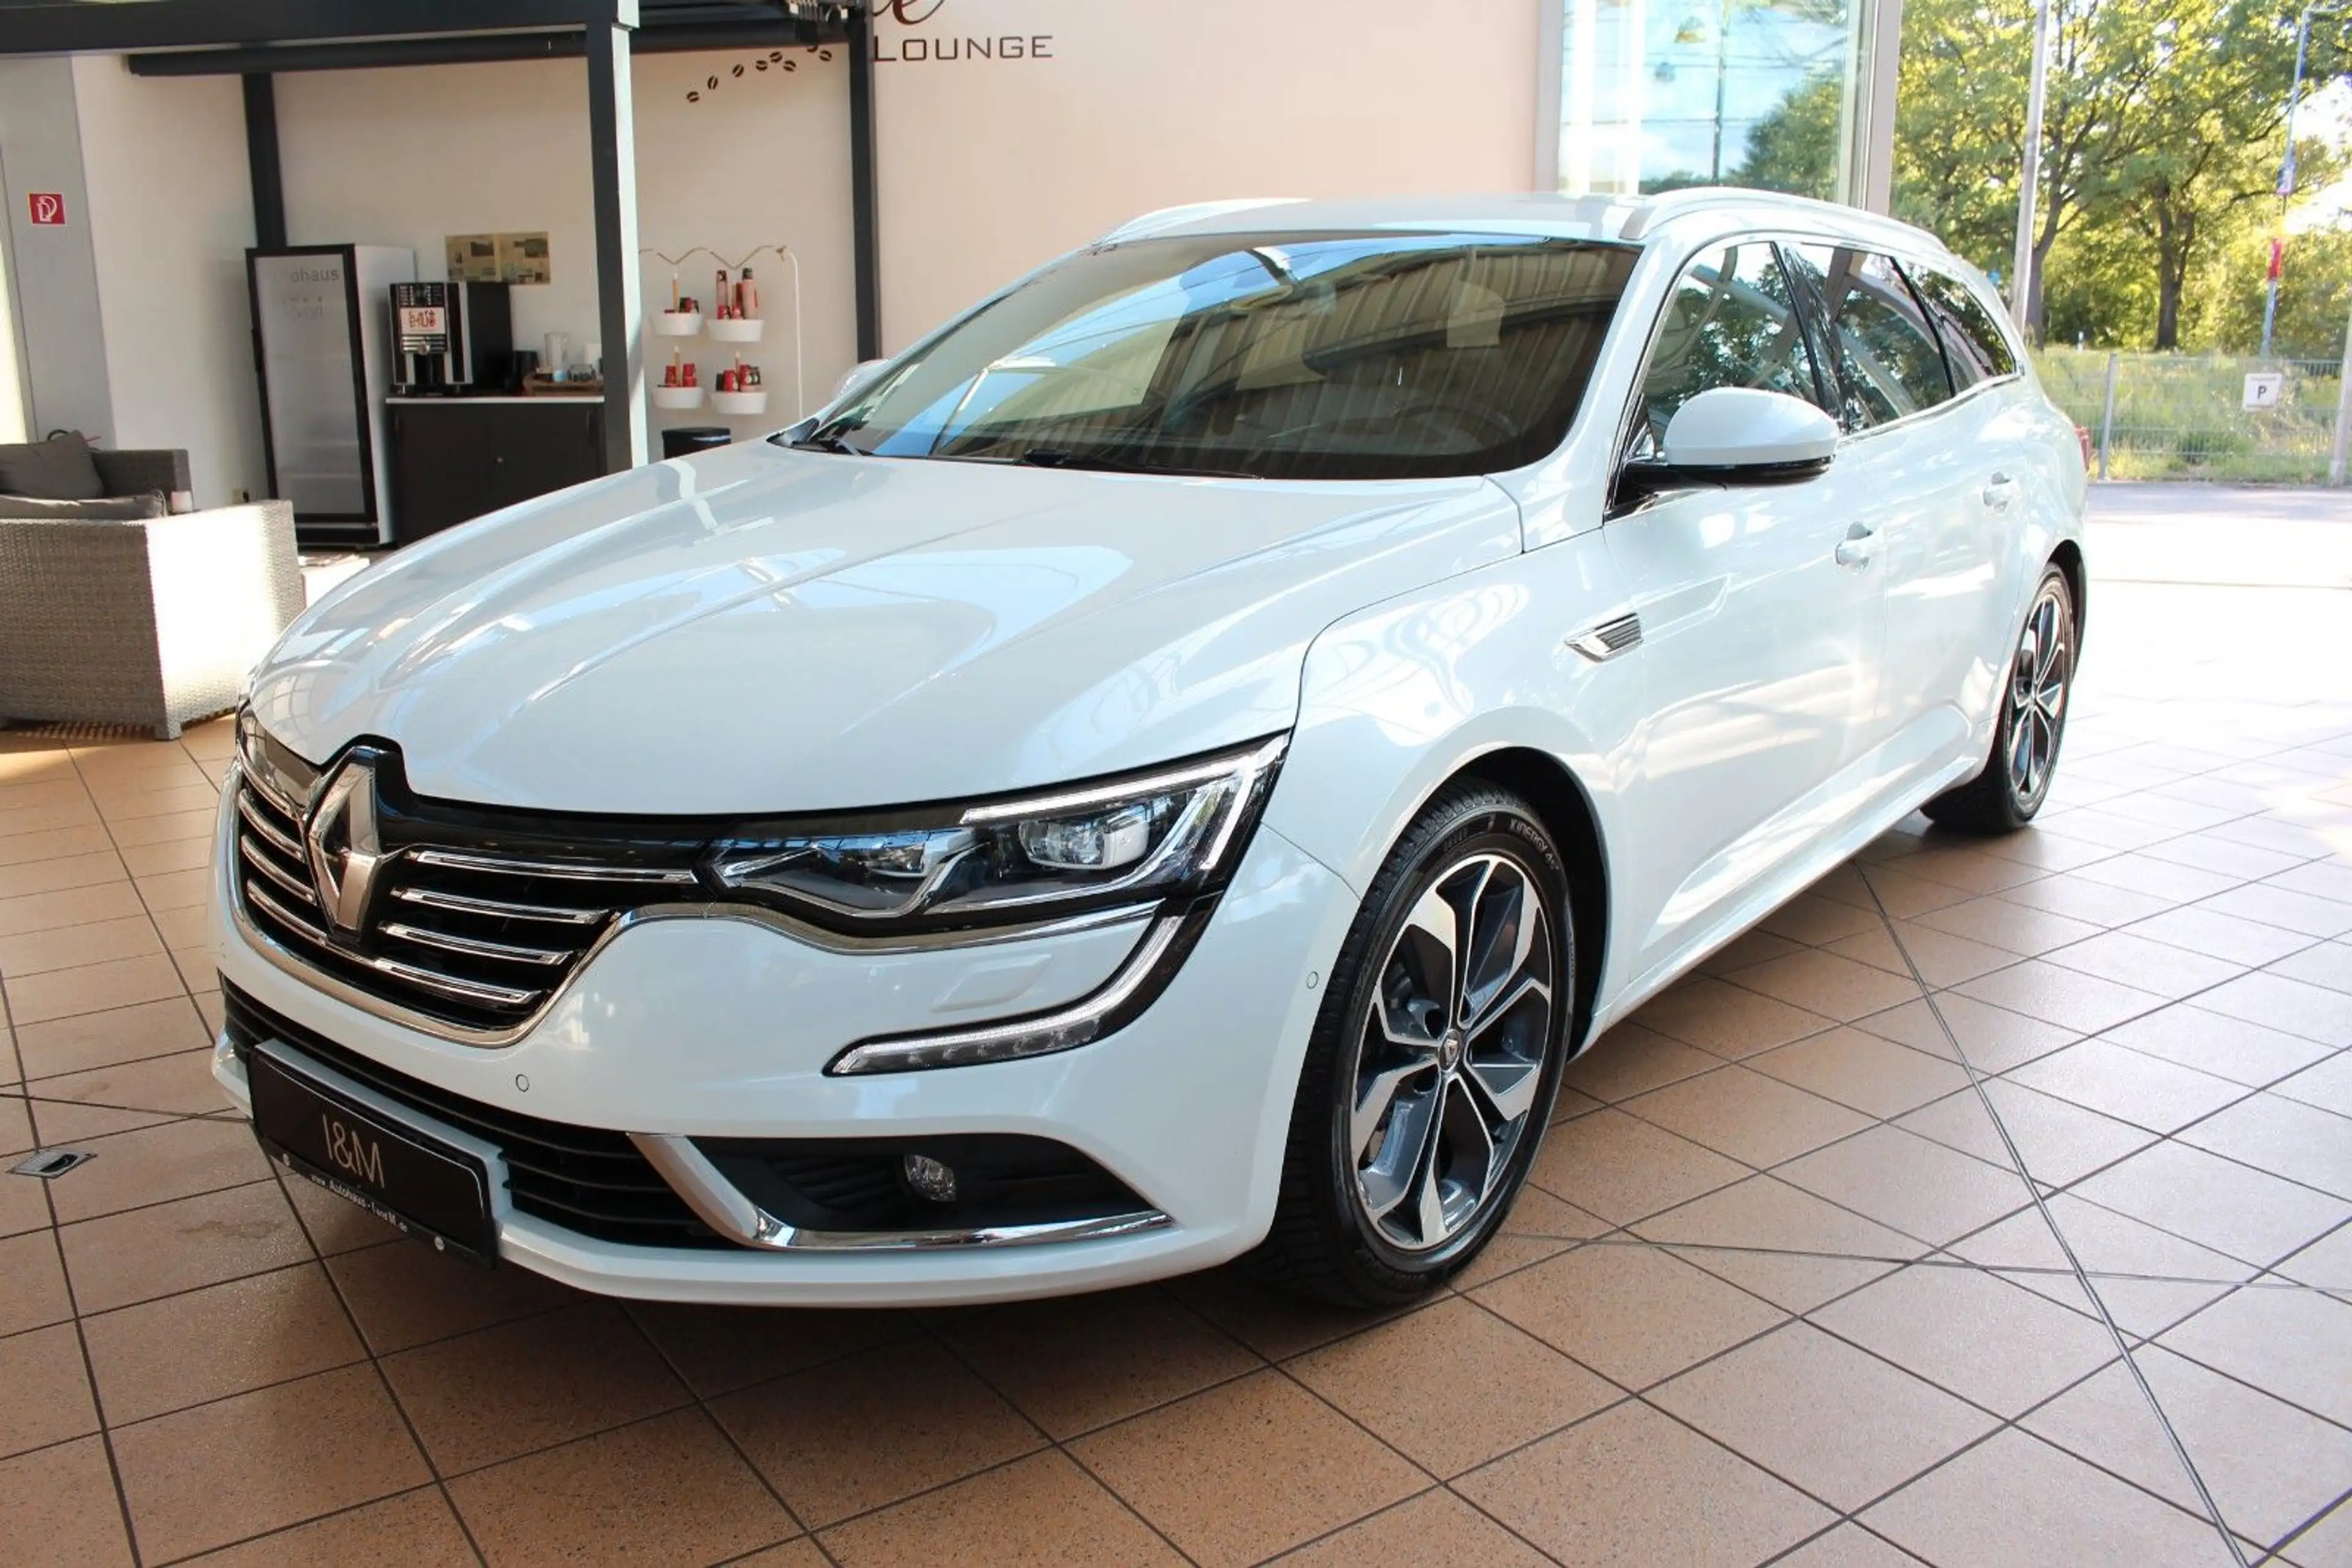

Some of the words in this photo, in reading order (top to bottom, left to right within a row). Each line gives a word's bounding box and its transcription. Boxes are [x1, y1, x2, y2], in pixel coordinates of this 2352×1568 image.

[873, 35, 1053, 62] LOUNGE
[2257, 385, 2267, 399] P
[322, 1114, 385, 1188] I&M
